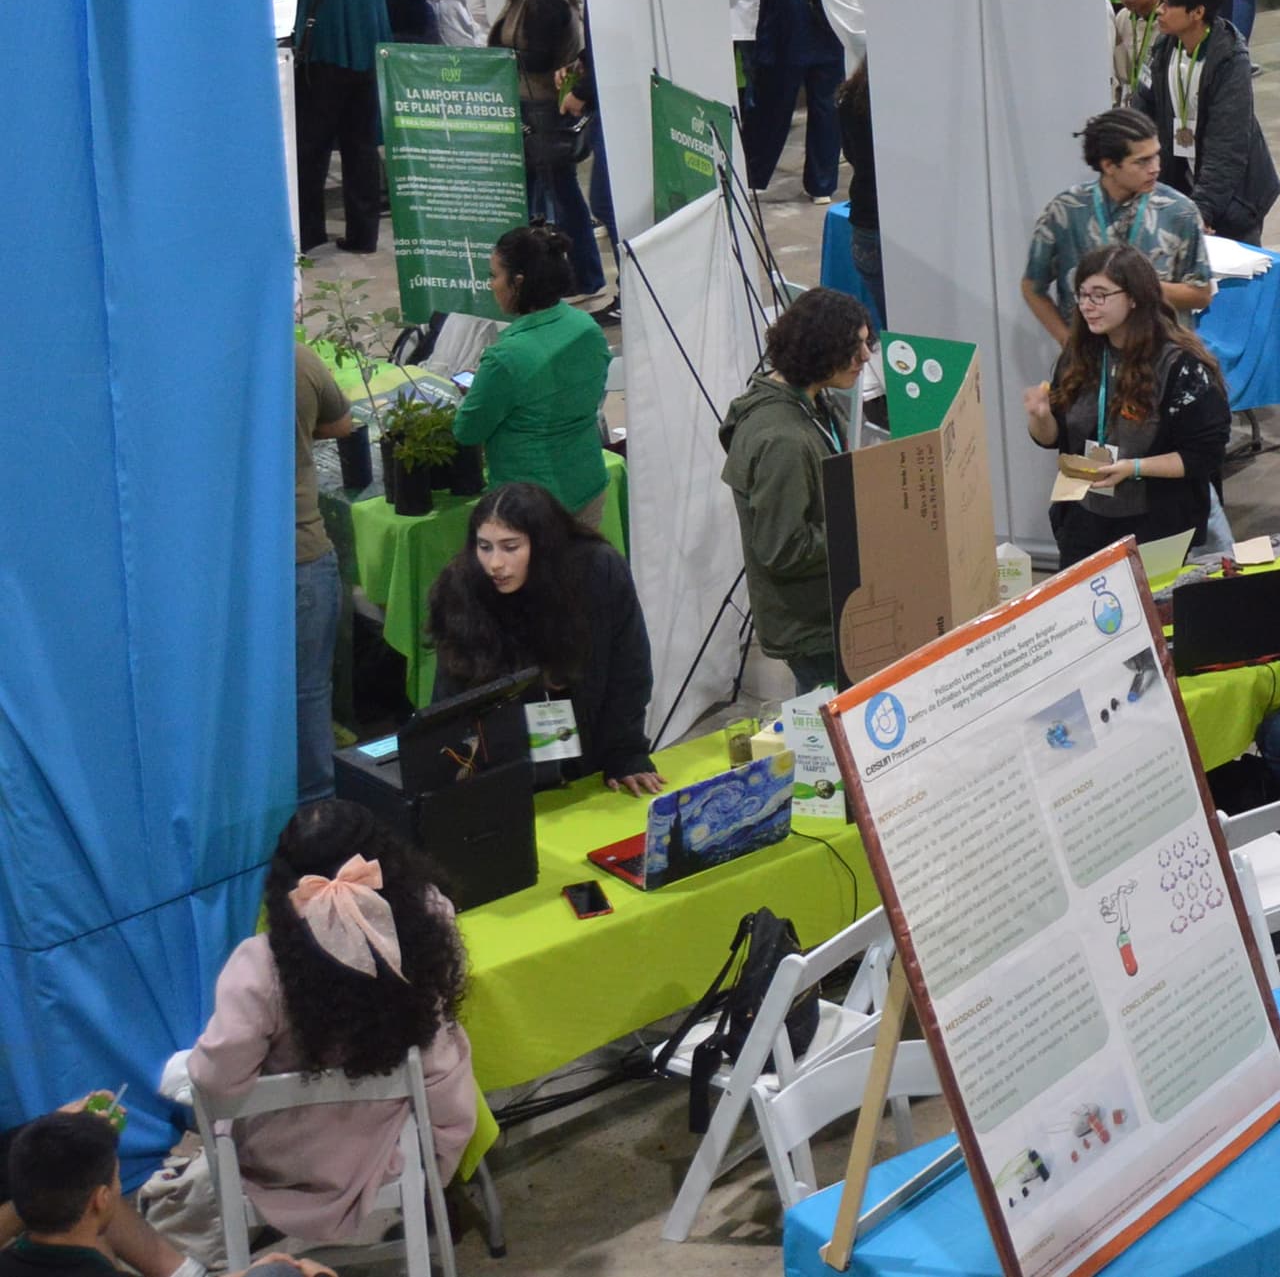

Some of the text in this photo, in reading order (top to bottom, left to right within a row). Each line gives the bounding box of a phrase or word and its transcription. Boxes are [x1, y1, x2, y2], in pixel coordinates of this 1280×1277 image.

[406, 88, 504, 104] LA IMPORTANCIA
[395, 101, 516, 118] DE PLANTAR ÁRBOLES
[670, 127, 726, 162] BIODIVERSIDD
[409, 274, 492, 292] ¡ÚNETE A NACIÓ
[865, 736, 927, 776] cesun Preparatoria
